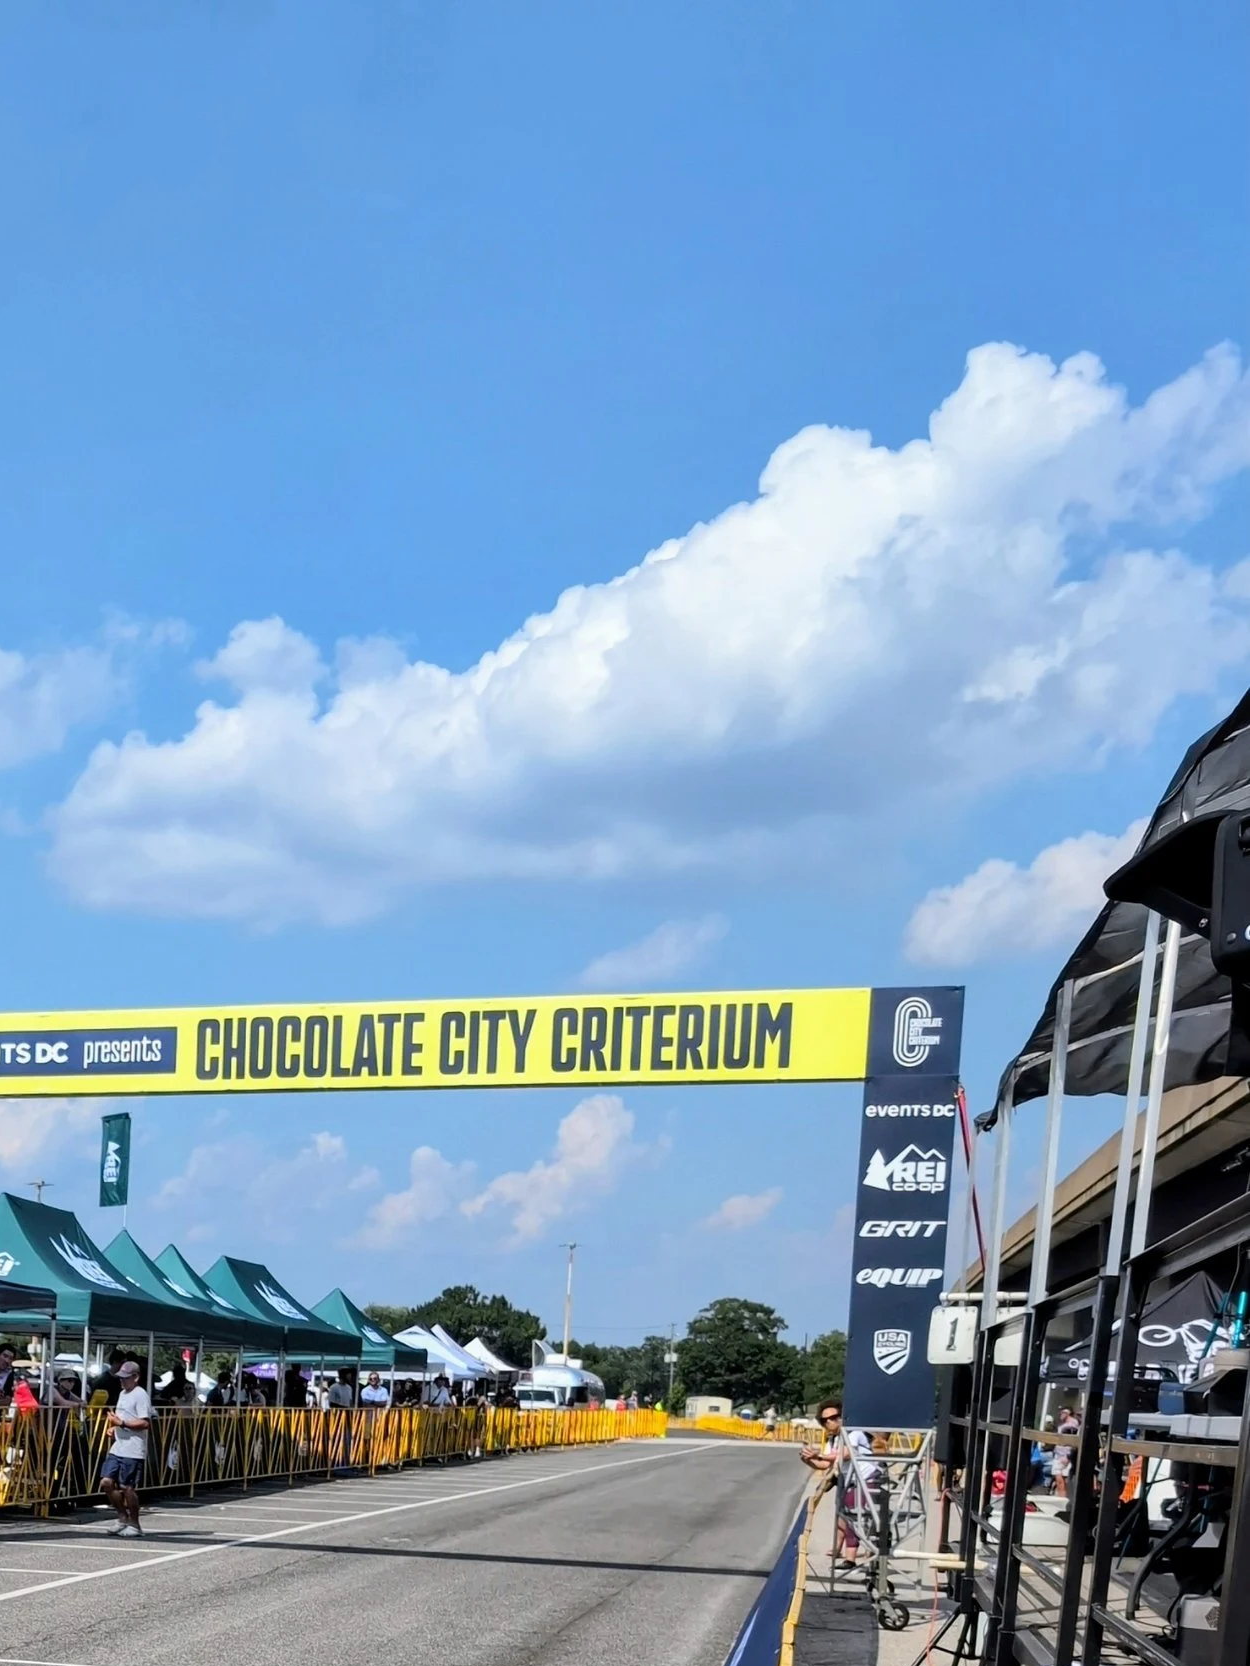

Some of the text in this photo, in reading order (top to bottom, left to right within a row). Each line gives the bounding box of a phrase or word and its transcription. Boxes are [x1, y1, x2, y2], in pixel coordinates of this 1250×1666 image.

[195, 1002, 793, 1080] CHOCOLATE CITY CRITERIUM
[34, 1041, 69, 1064] DC
[83, 1035, 162, 1069] presents
[865, 1104, 955, 1117] events DC
[892, 1161, 946, 1182] REI
[858, 1220, 948, 1237] GRIT
[878, 1333, 906, 1342] USA
[946, 1317, 959, 1351] 1
